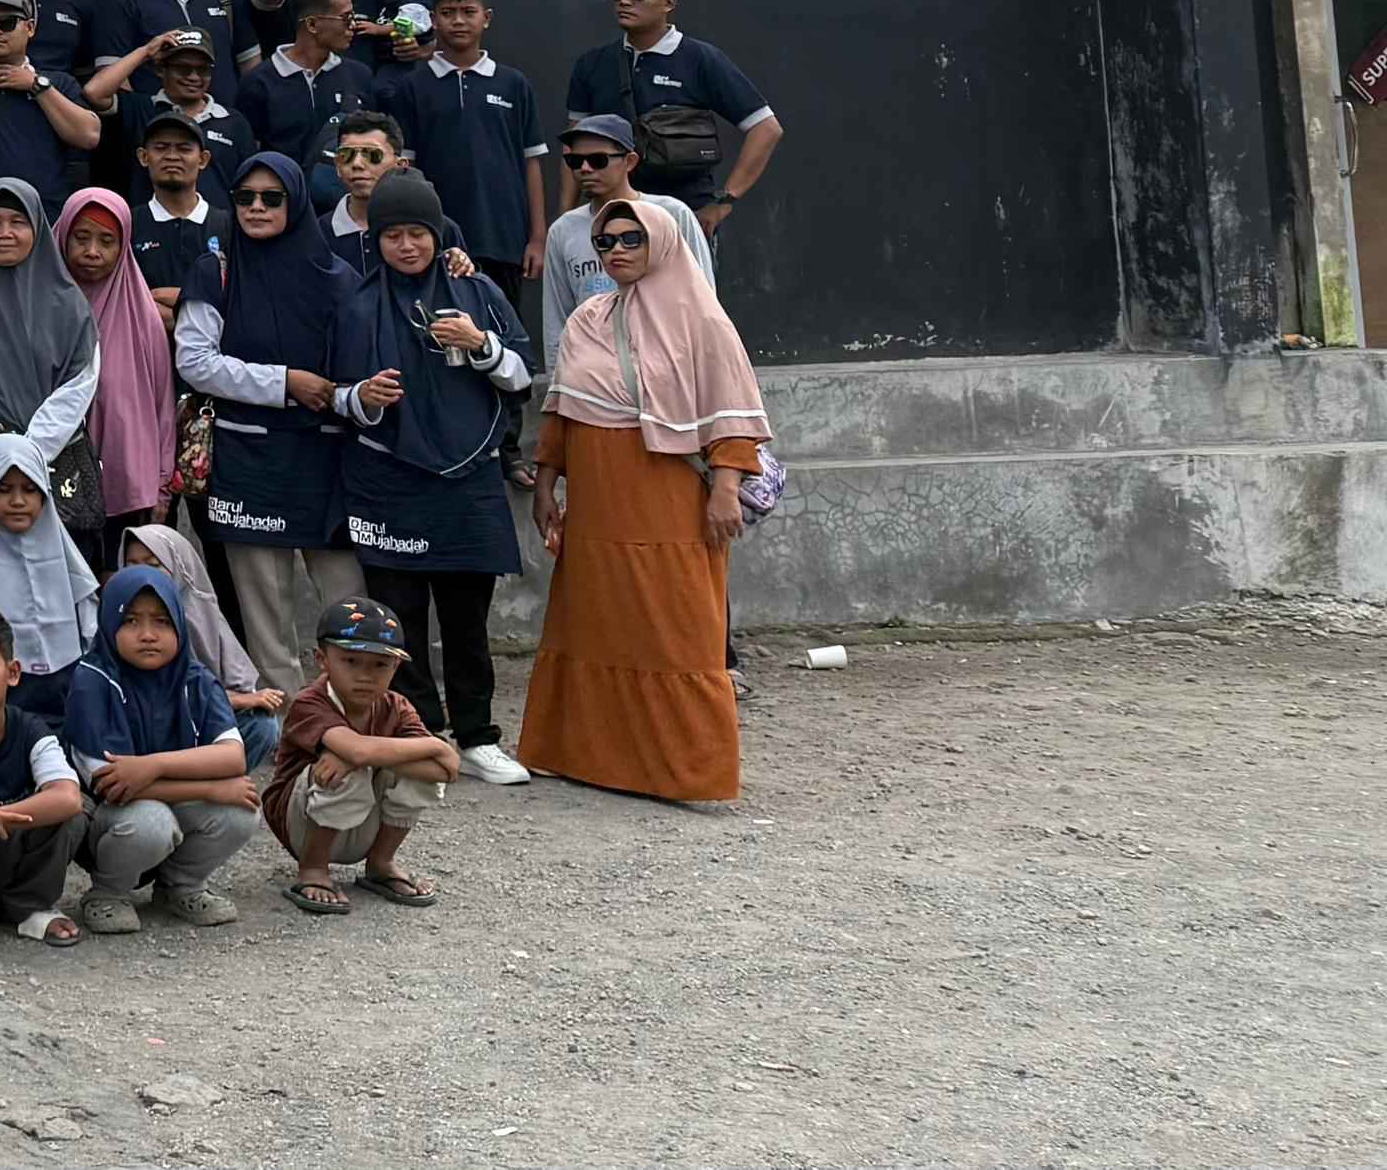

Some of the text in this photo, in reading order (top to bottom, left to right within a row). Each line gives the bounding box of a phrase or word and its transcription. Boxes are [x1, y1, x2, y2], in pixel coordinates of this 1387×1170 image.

[1362, 47, 1387, 86] SUP
[208, 496, 243, 513] Darul
[216, 510, 286, 532] Mujahadah
[348, 516, 386, 535] Darul
[360, 531, 429, 554] Mujahadah
